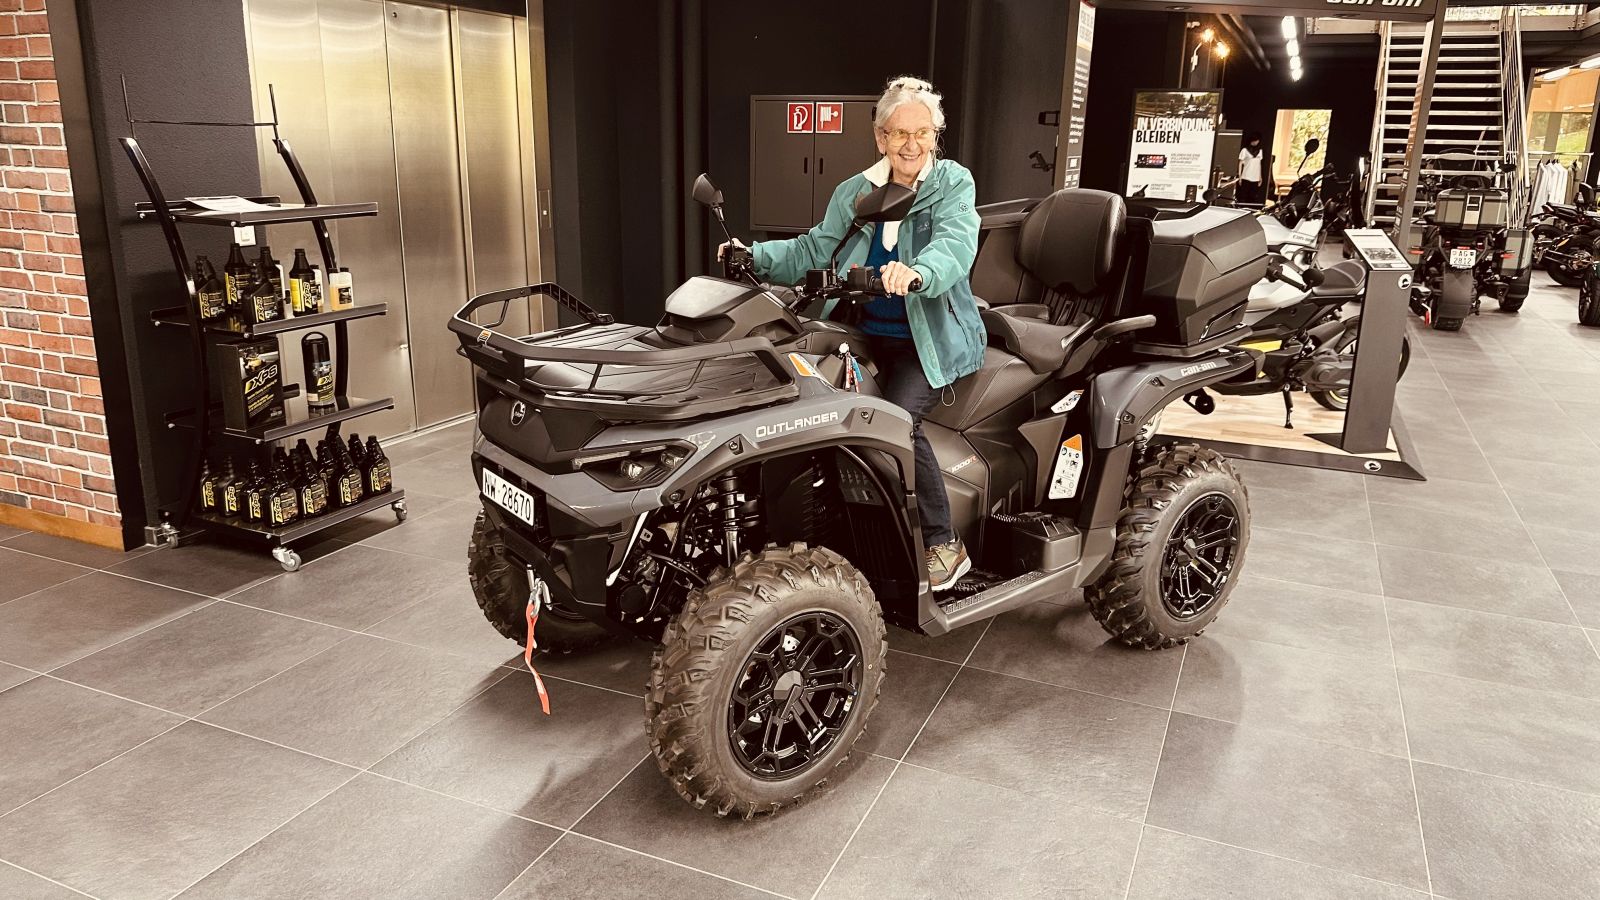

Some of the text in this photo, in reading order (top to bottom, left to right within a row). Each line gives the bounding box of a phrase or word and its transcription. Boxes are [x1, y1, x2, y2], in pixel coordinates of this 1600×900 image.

[1150, 117, 1214, 131] VERBINDUNG
[1135, 130, 1180, 143] BLEIBEN
[1180, 361, 1217, 377] can-am
[755, 411, 839, 438] OUTLANDER
[502, 483, 531, 521] 28670
